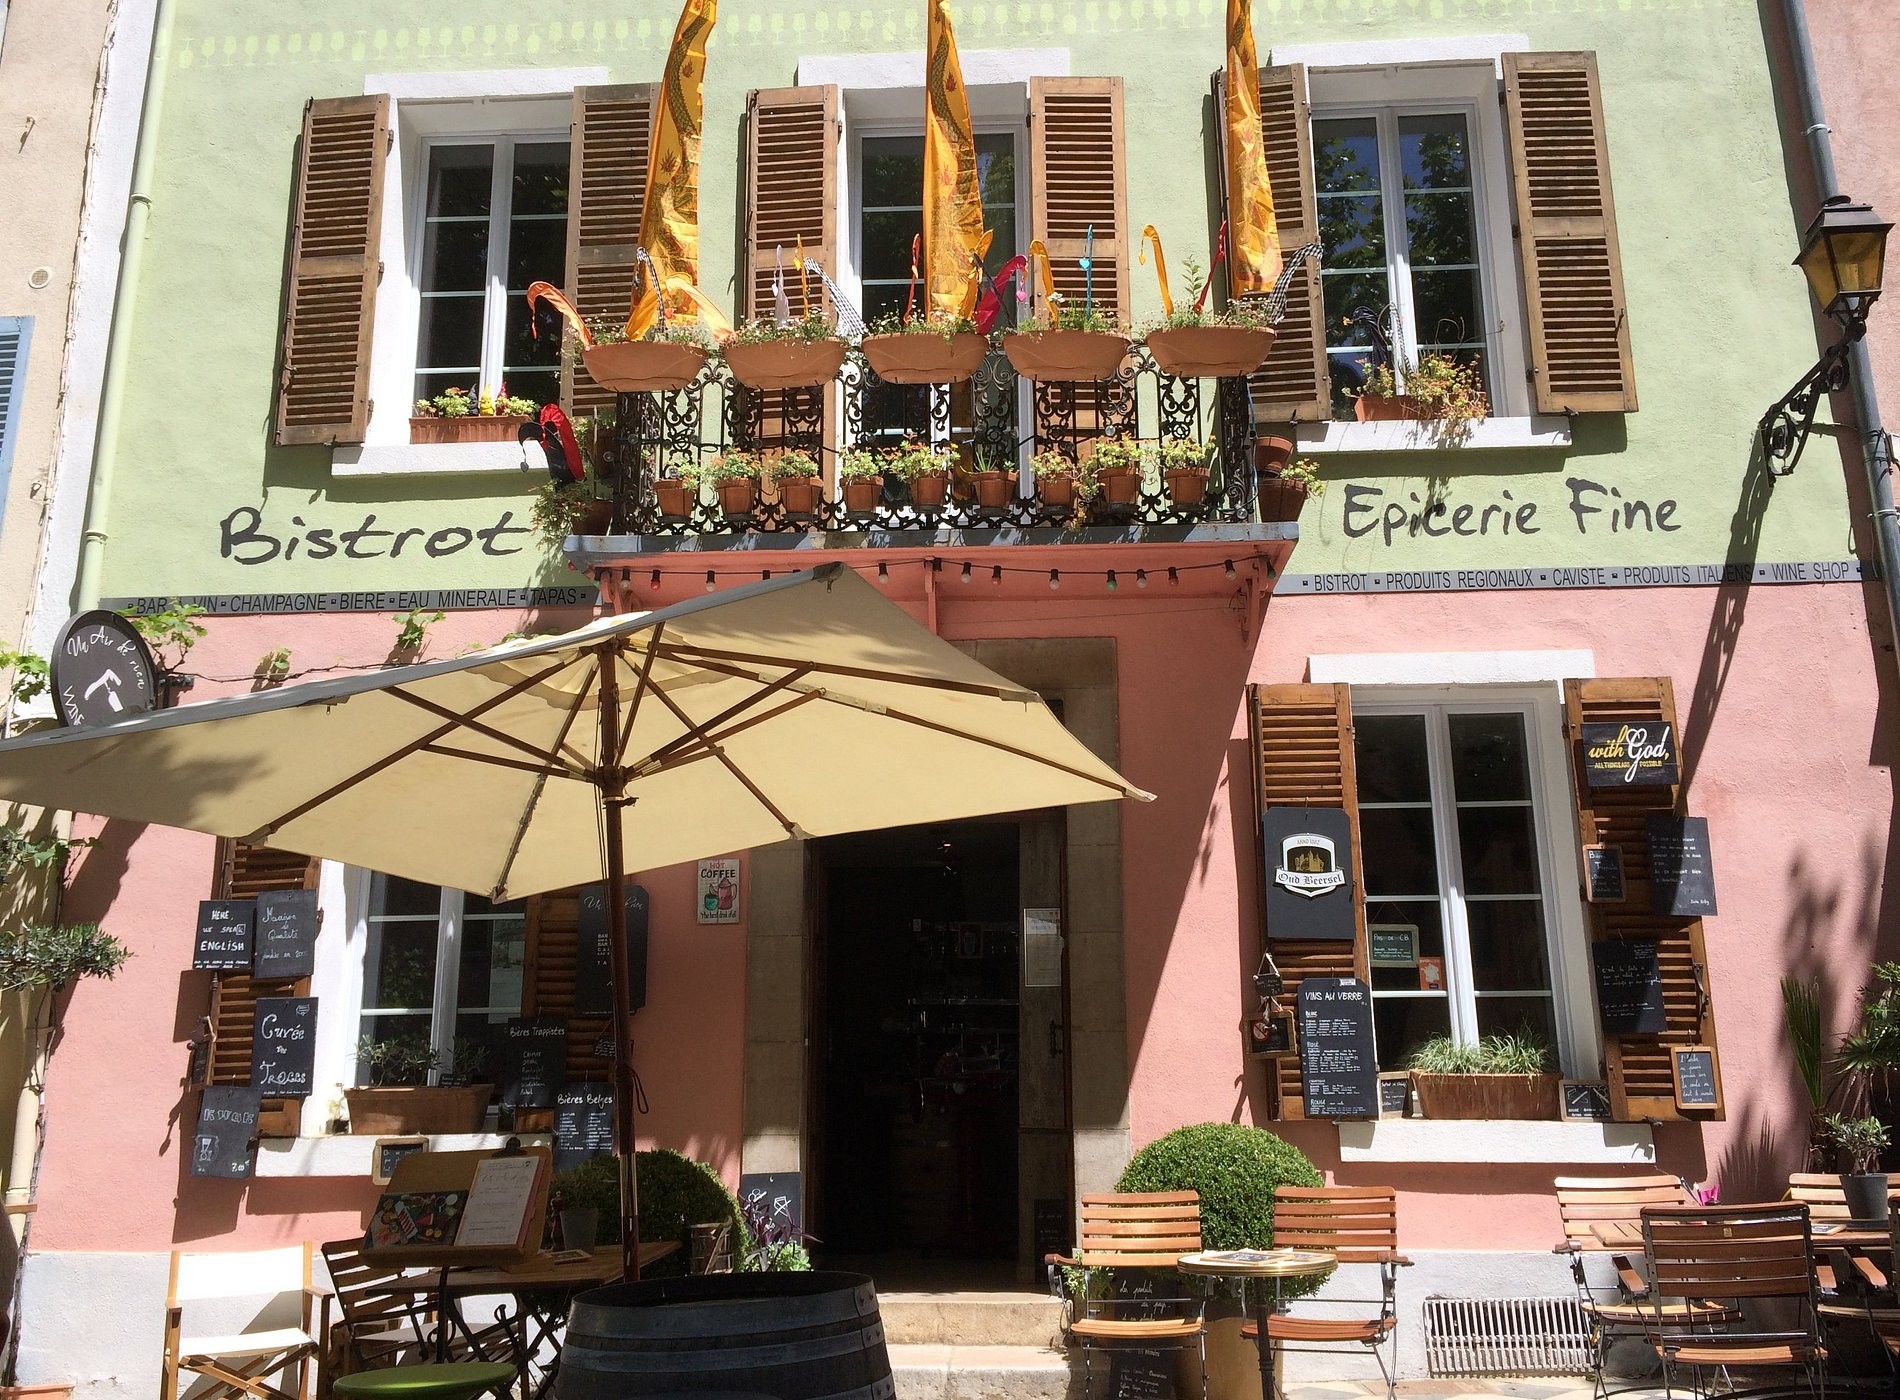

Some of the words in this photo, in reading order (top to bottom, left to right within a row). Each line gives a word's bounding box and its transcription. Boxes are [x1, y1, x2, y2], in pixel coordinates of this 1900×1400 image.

[1343, 484, 1540, 546] Epicerie
[1566, 477, 1682, 534] Fine
[220, 506, 531, 565] Bistrot
[1314, 574, 1367, 592] BISTROT
[1387, 572, 1451, 590] PRODUITS
[1458, 569, 1534, 588] REGIONAUX
[1553, 568, 1605, 585] CAVISTE
[1624, 566, 1691, 584] PRODUITS
[1697, 563, 1751, 582] ITALIENS
[1772, 563, 1806, 580] WINE
[1814, 562, 1849, 580] SHOP
[136, 598, 167, 614] BAR
[230, 594, 326, 612] CHAMPAGNE
[340, 593, 385, 610] BIERE
[398, 591, 429, 609] EAU
[438, 589, 516, 608] MINERALE
[531, 588, 577, 605] TAPAS
[90, 626, 113, 646] Air
[116, 640, 136, 656] de
[1588, 725, 1629, 758] with
[1625, 726, 1670, 783] God,
[701, 869, 736, 878] COFFEE
[1278, 873, 1300, 884] Oud
[1303, 874, 1342, 886] Beersel
[1305, 992, 1322, 1001] VINS
[1325, 992, 1335, 1001] AU
[1338, 992, 1363, 1001] VERRE
[557, 1092, 583, 1105] Bières
[587, 1093, 613, 1109] Belges
